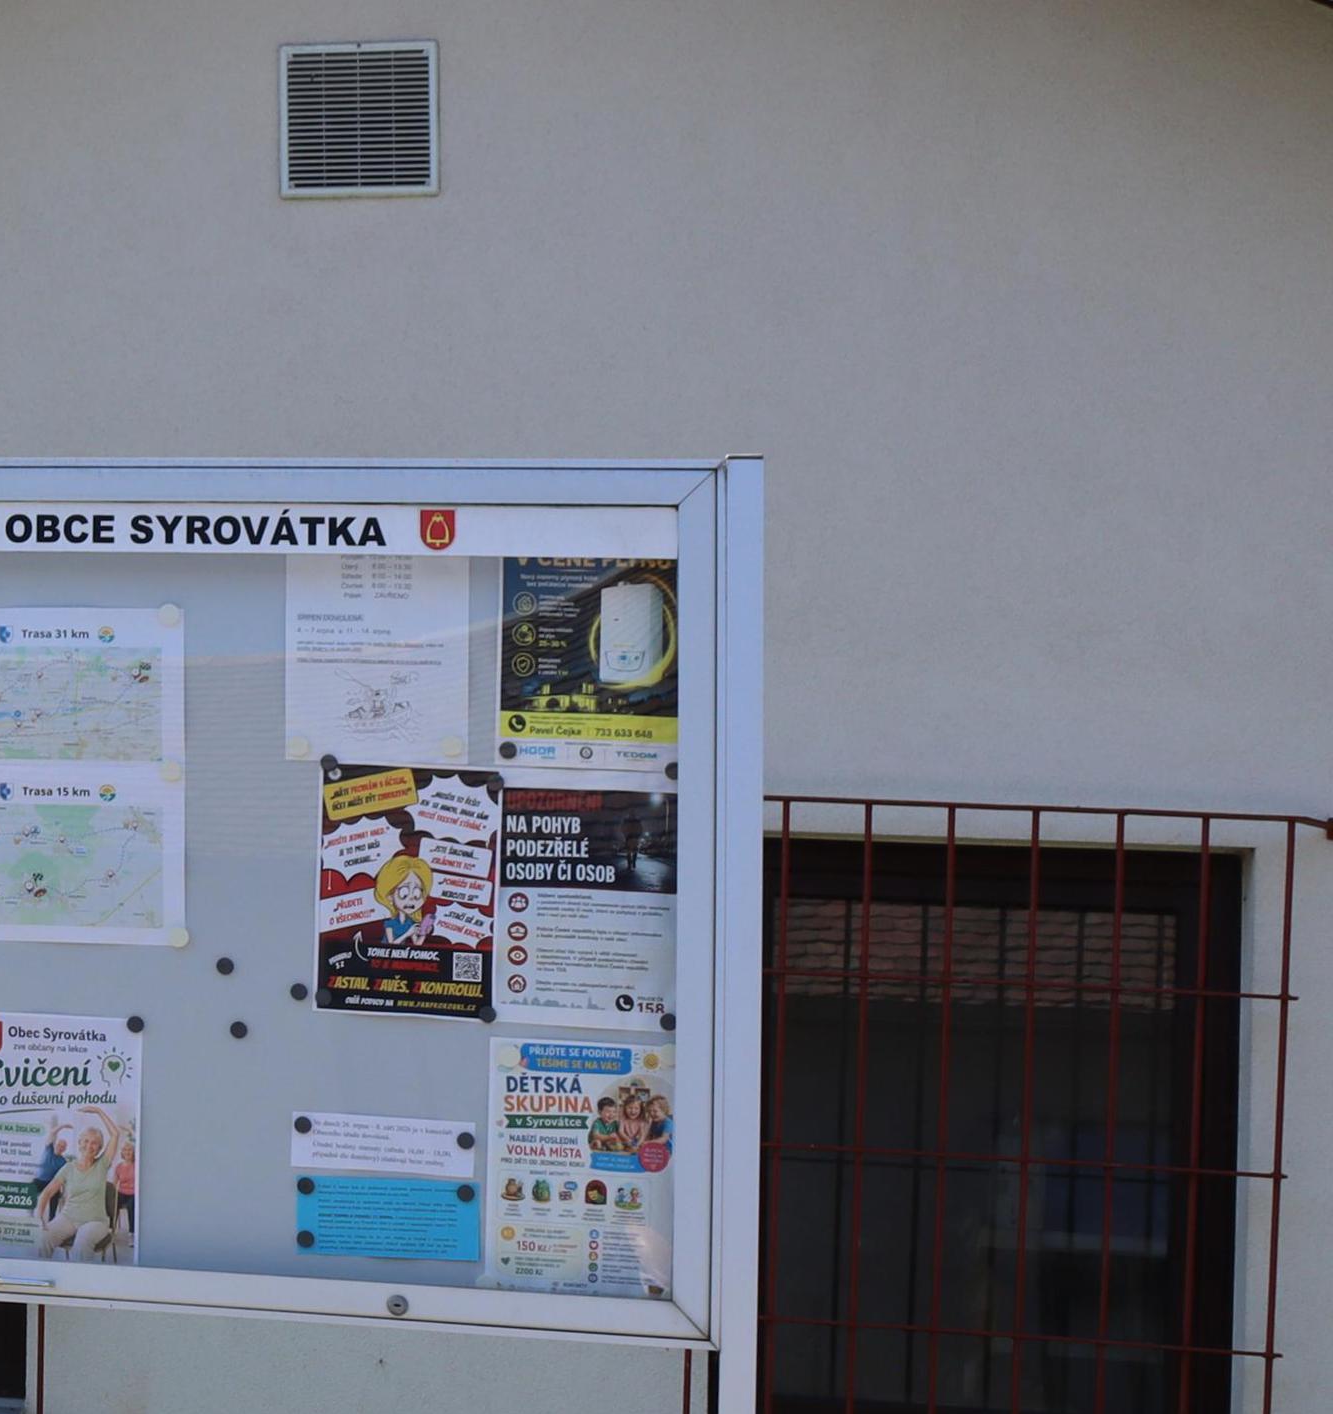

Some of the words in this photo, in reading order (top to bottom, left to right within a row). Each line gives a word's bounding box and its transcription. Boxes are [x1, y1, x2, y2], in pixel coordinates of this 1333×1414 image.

[5, 514, 116, 544] OBCE
[129, 509, 386, 546] SYROVÁTKA
[22, 629, 52, 639] Trasa
[55, 629, 68, 638] 31
[71, 629, 89, 639] km
[22, 787, 53, 796] Trasa
[57, 787, 69, 796] 15
[72, 787, 90, 797] km
[506, 815, 527, 833] NA
[532, 816, 581, 833] POHYB
[506, 837, 589, 858] PODEZŘELÉ
[506, 863, 554, 881] OSOBY
[557, 861, 571, 881] ČI
[576, 864, 615, 883] OSOB
[367, 947, 391, 957] TOHLE
[391, 946, 409, 959] NENÍ
[328, 975, 370, 991] ZASTAV.
[374, 974, 410, 993] ZAVĚS.
[412, 981, 483, 998] ZKONTROLUJ.
[637, 1002, 665, 1014] 158
[8, 1026, 41, 1039] Obec
[43, 1027, 107, 1043] Syrovátka
[28, 1044, 55, 1053] občany
[68, 1044, 88, 1053] lekce
[529, 1046, 566, 1057] PŘIJĎTE
[568, 1047, 580, 1058] SE
[585, 1060, 599, 1070] NA
[506, 1072, 582, 1094] DĚTSKÁ
[12, 1090, 65, 1106] duševní
[67, 1090, 117, 1109] pohodu
[504, 1095, 593, 1113] SKUPINA
[515, 1118, 523, 1126] v
[526, 1116, 582, 1128] Syrovátce
[509, 1134, 537, 1144] NABÍZÍ
[539, 1134, 579, 1145] POSLEDNÍ
[506, 1144, 547, 1157] VOLNÁ
[549, 1146, 582, 1159] MÍSTA
[516, 1241, 536, 1252] 150
